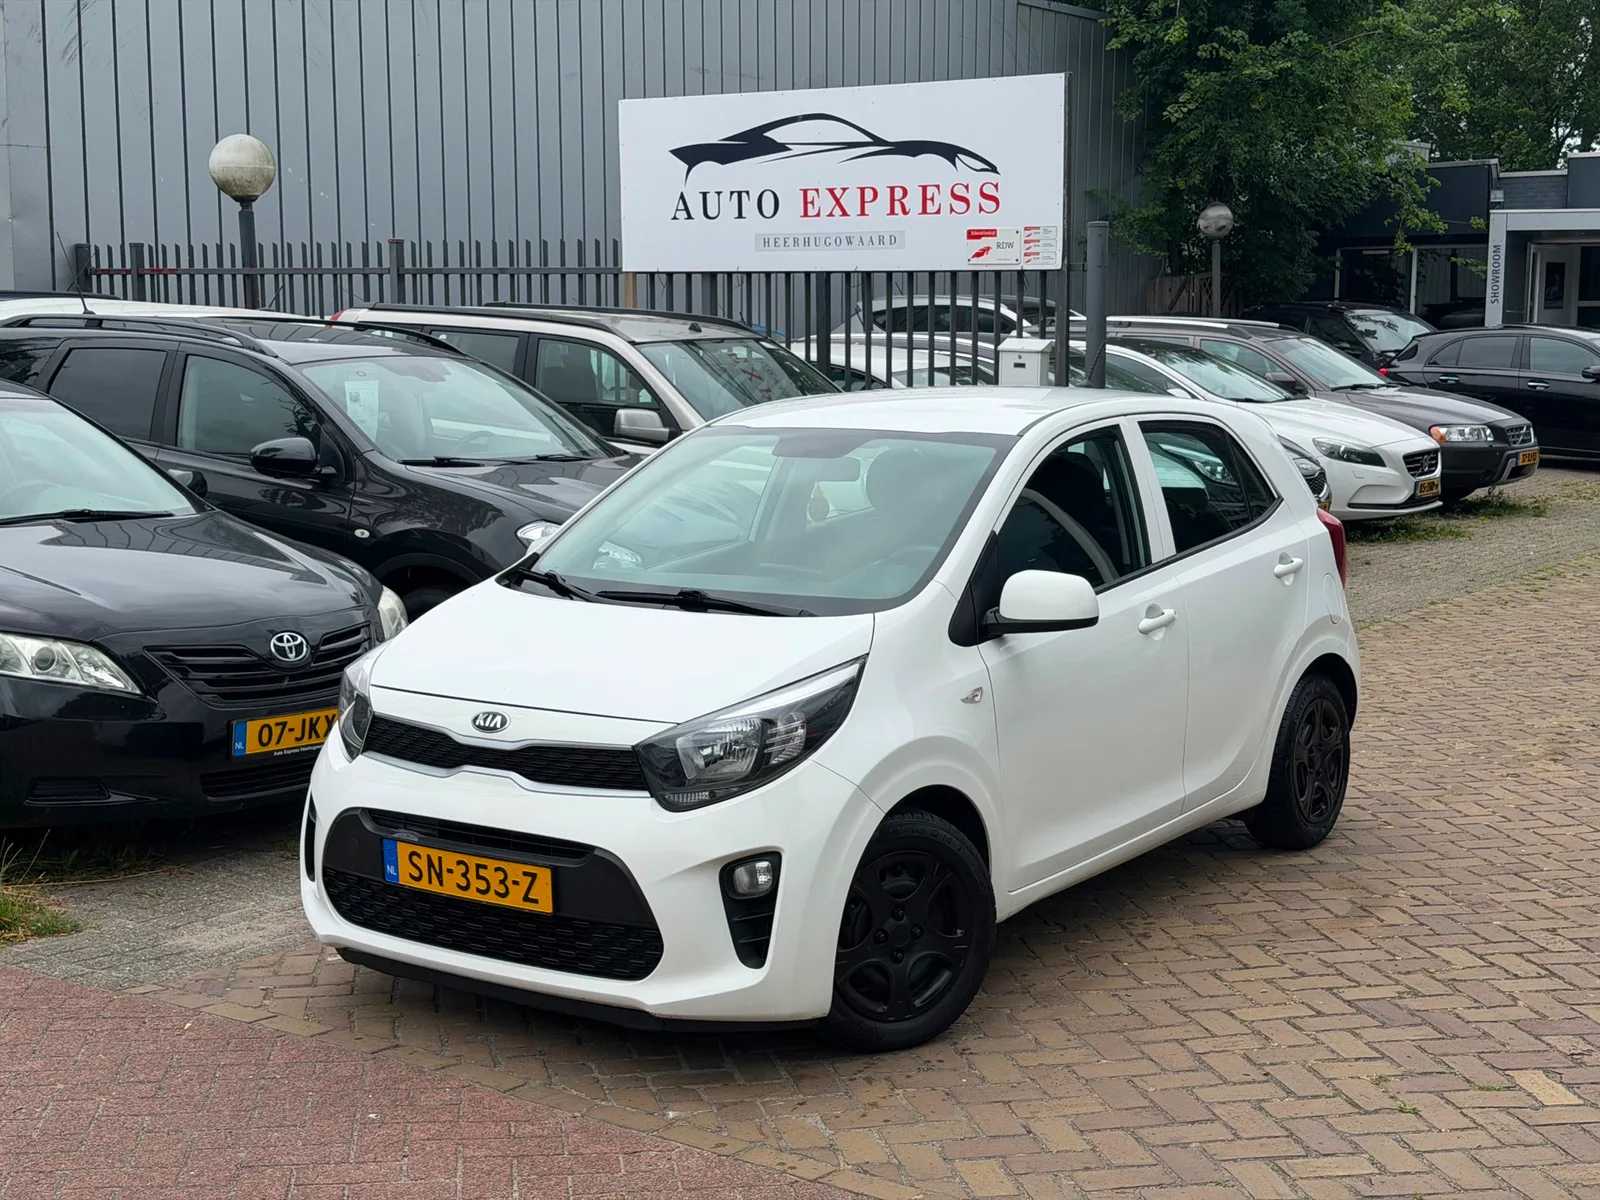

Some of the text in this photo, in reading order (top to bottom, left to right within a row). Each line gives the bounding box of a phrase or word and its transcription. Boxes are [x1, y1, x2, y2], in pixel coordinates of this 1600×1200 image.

[671, 181, 1001, 221] AUTO EXPRESS
[762, 234, 898, 248] HEERHUGOWAARD
[996, 241, 1015, 250] RDW
[1490, 244, 1501, 304] SHOWROOM
[234, 713, 337, 750] NL 07-JKX
[475, 713, 502, 729] KIA
[386, 850, 540, 905] NL SN-353-Z
